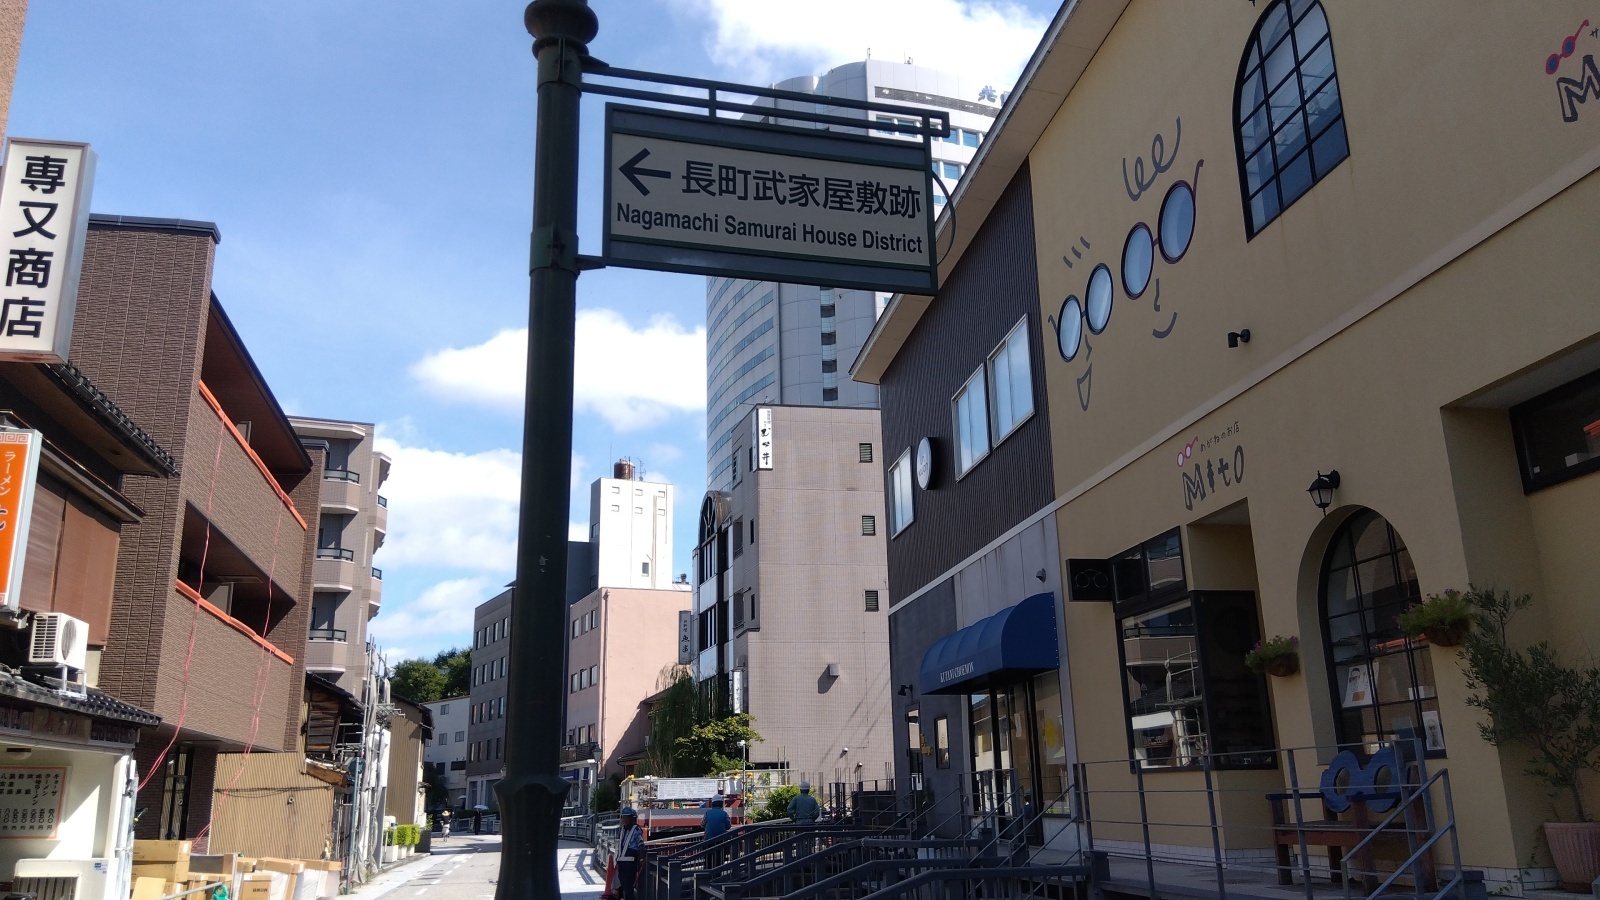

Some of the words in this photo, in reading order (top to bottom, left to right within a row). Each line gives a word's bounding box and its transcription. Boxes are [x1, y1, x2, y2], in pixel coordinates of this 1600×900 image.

[681, 159, 921, 220] 長町武家屋敷跡
[0, 155, 68, 338] 専又商店
[616, 203, 719, 233] Nagamachi
[724, 215, 797, 242] Samurai
[802, 223, 857, 248] House
[862, 230, 923, 254] District
